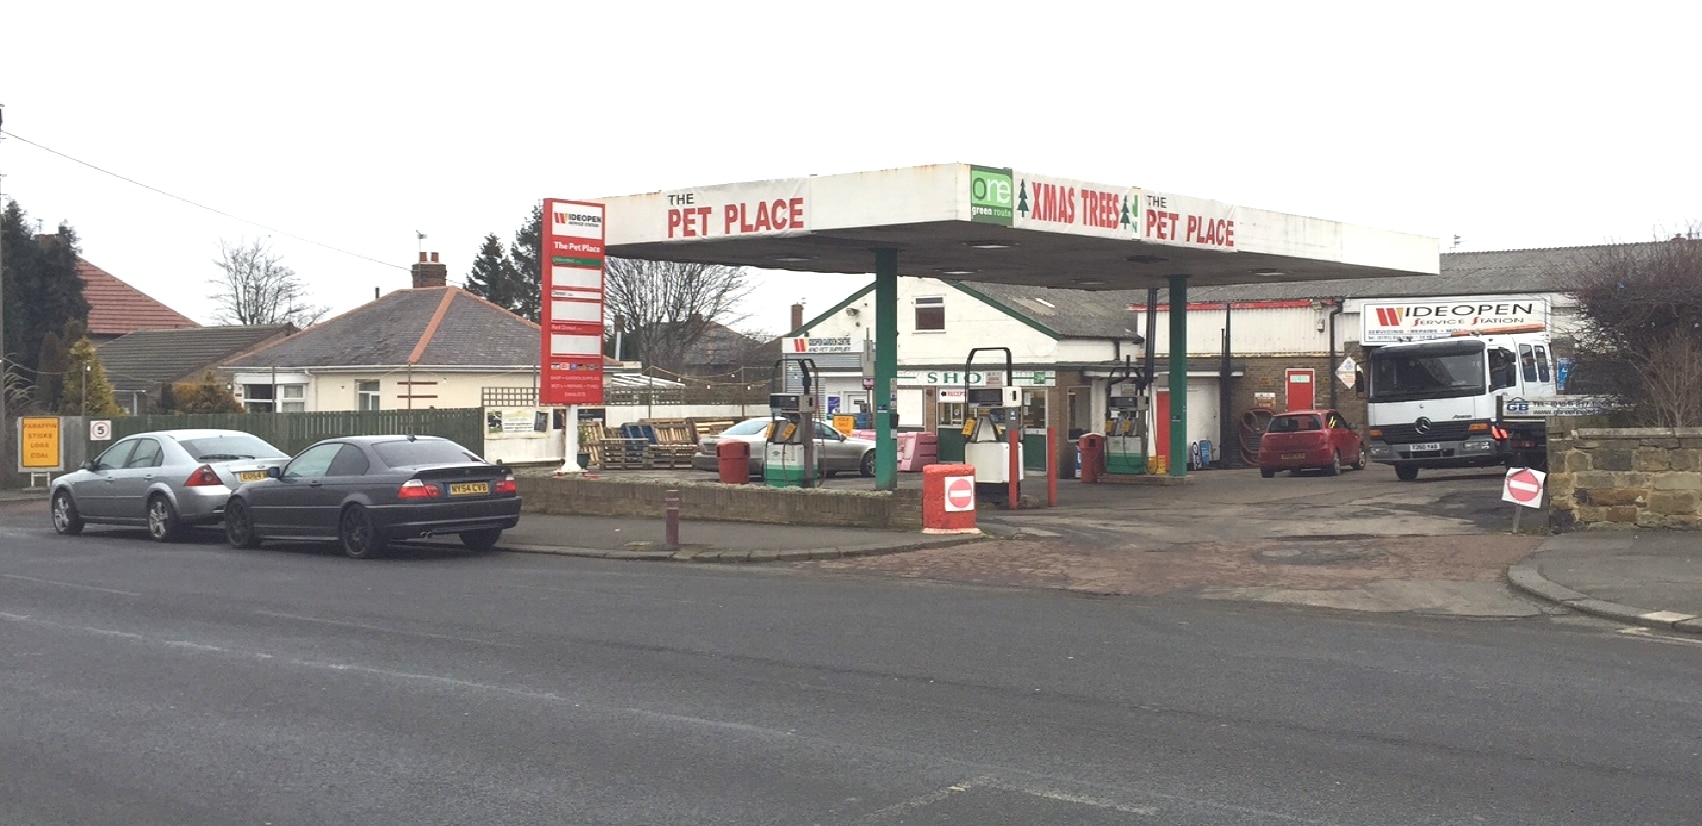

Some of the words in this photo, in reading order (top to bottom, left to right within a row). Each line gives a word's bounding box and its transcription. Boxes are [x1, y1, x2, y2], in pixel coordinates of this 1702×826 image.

[972, 177, 1011, 204] one
[668, 194, 694, 204] THE
[1147, 195, 1167, 208] THE
[1031, 182, 1075, 224] XMAS
[1081, 189, 1120, 229] TREES
[668, 207, 712, 238] PET
[724, 197, 804, 234] PLACE
[971, 206, 993, 216] green
[994, 208, 1012, 218] route
[1146, 209, 1179, 240] PET
[1186, 215, 1234, 247] PLACE
[554, 241, 568, 249] The
[569, 242, 581, 251] Pet
[581, 244, 601, 253] Place
[1413, 318, 1465, 327] SERVICE
[1472, 317, 1524, 326] STATION
[927, 372, 982, 384] SHO
[1507, 403, 1530, 411] GB
[97, 427, 105, 435] 5
